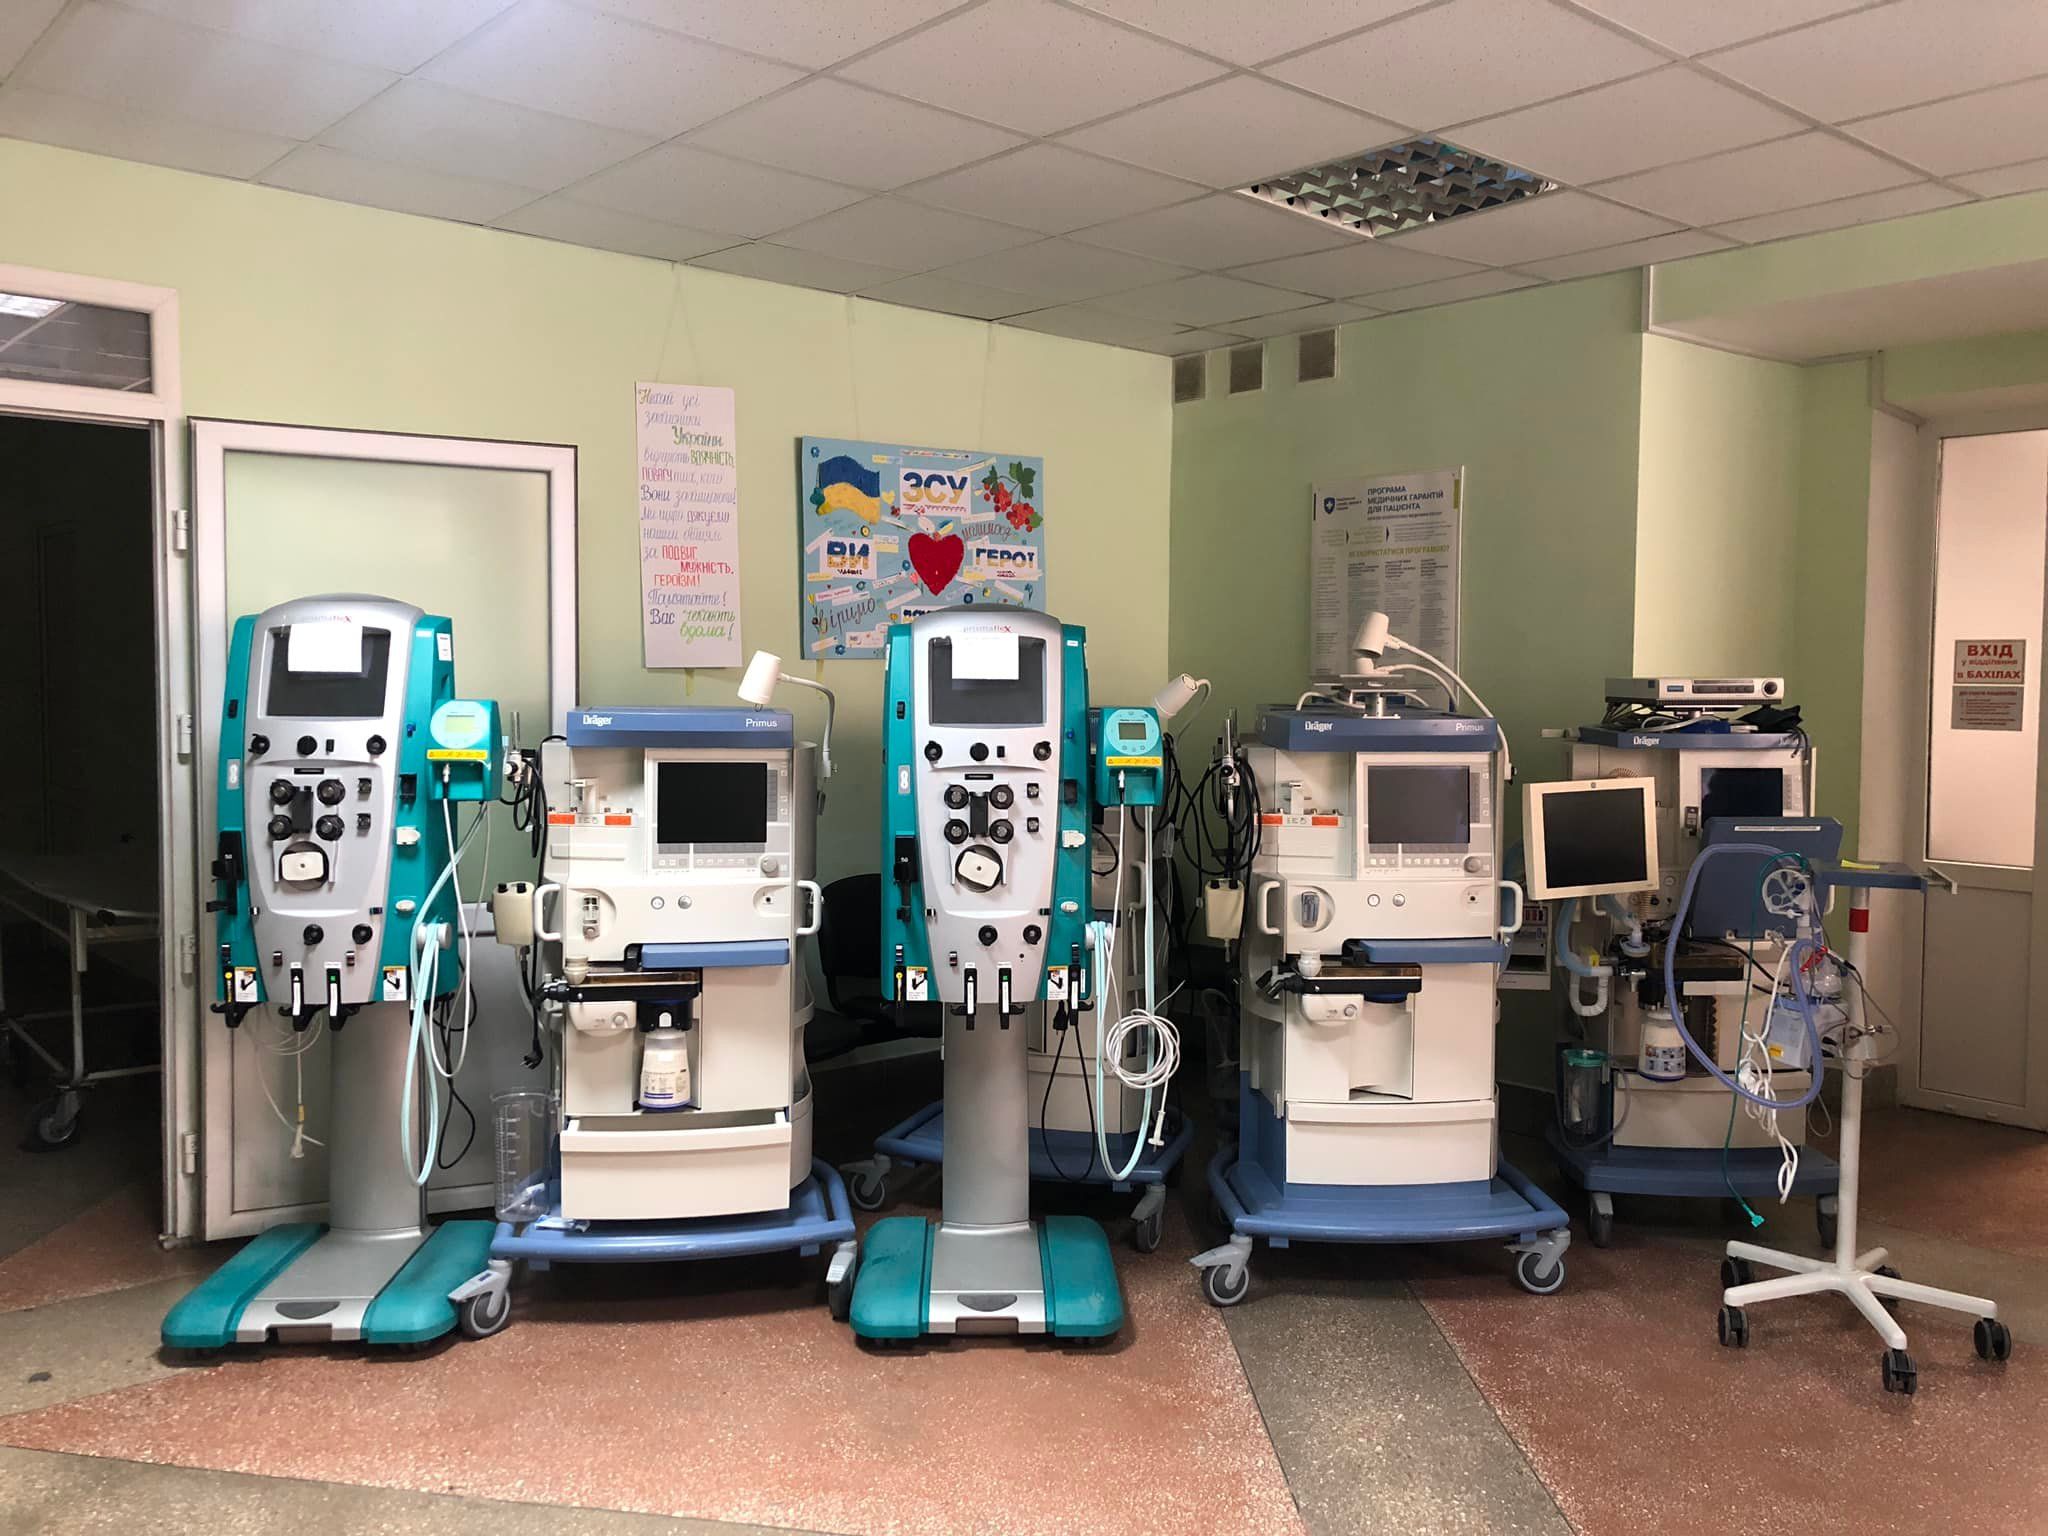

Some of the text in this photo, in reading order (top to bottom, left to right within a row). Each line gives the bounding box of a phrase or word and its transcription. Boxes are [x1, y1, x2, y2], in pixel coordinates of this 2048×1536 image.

[640, 484, 671, 501] Вони
[903, 471, 968, 504] ЗСУ
[1367, 485, 1407, 497] ПРОГРАМА
[1367, 493, 1408, 505] МЕДИЧНИХ
[1409, 490, 1444, 501] ГАРАНТІЙ
[1367, 502, 1421, 514] ДЛЯ ПАЦІЄНТА
[827, 540, 870, 570] ВИ
[975, 547, 1035, 568] ГЕРОЇ
[649, 607, 676, 625] Вас
[1967, 644, 2013, 658] ВХІД
[1967, 670, 2021, 679] БАХІЛАХ
[582, 714, 613, 727] Dräger
[745, 718, 778, 728] Primus
[1305, 720, 1334, 733] Dräger
[1455, 722, 1485, 733] Primus
[1633, 736, 1660, 748] Dräger
